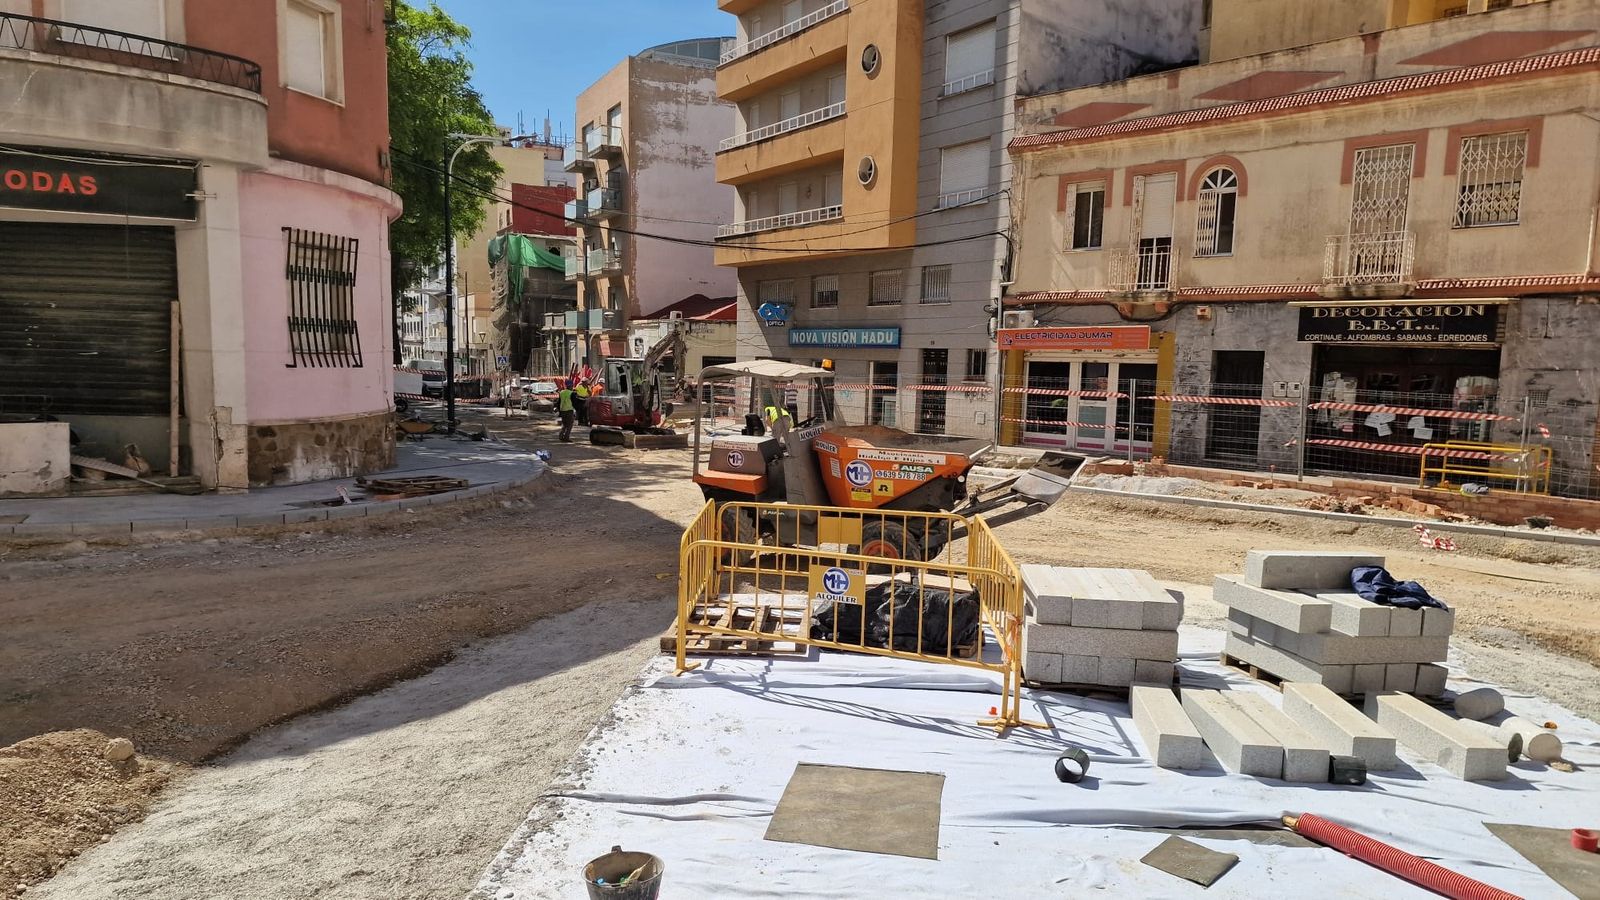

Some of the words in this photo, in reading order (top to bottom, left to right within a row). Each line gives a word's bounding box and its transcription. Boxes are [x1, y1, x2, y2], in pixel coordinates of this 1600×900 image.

[1312, 304, 1485, 318] DECORACION
[792, 331, 818, 344] NOVA
[861, 331, 894, 344] HADU
[1014, 331, 1077, 340] ELECTRICIDAD
[1078, 331, 1114, 340] DUMAR
[1304, 333, 1342, 341] CORTINAJE
[1347, 333, 1392, 342] ALFOMBRAS
[1396, 333, 1432, 342] SABANAS
[1438, 333, 1488, 342] EDREDONES
[900, 464, 934, 473] AUSA
[816, 592, 857, 604] ALQUILER
